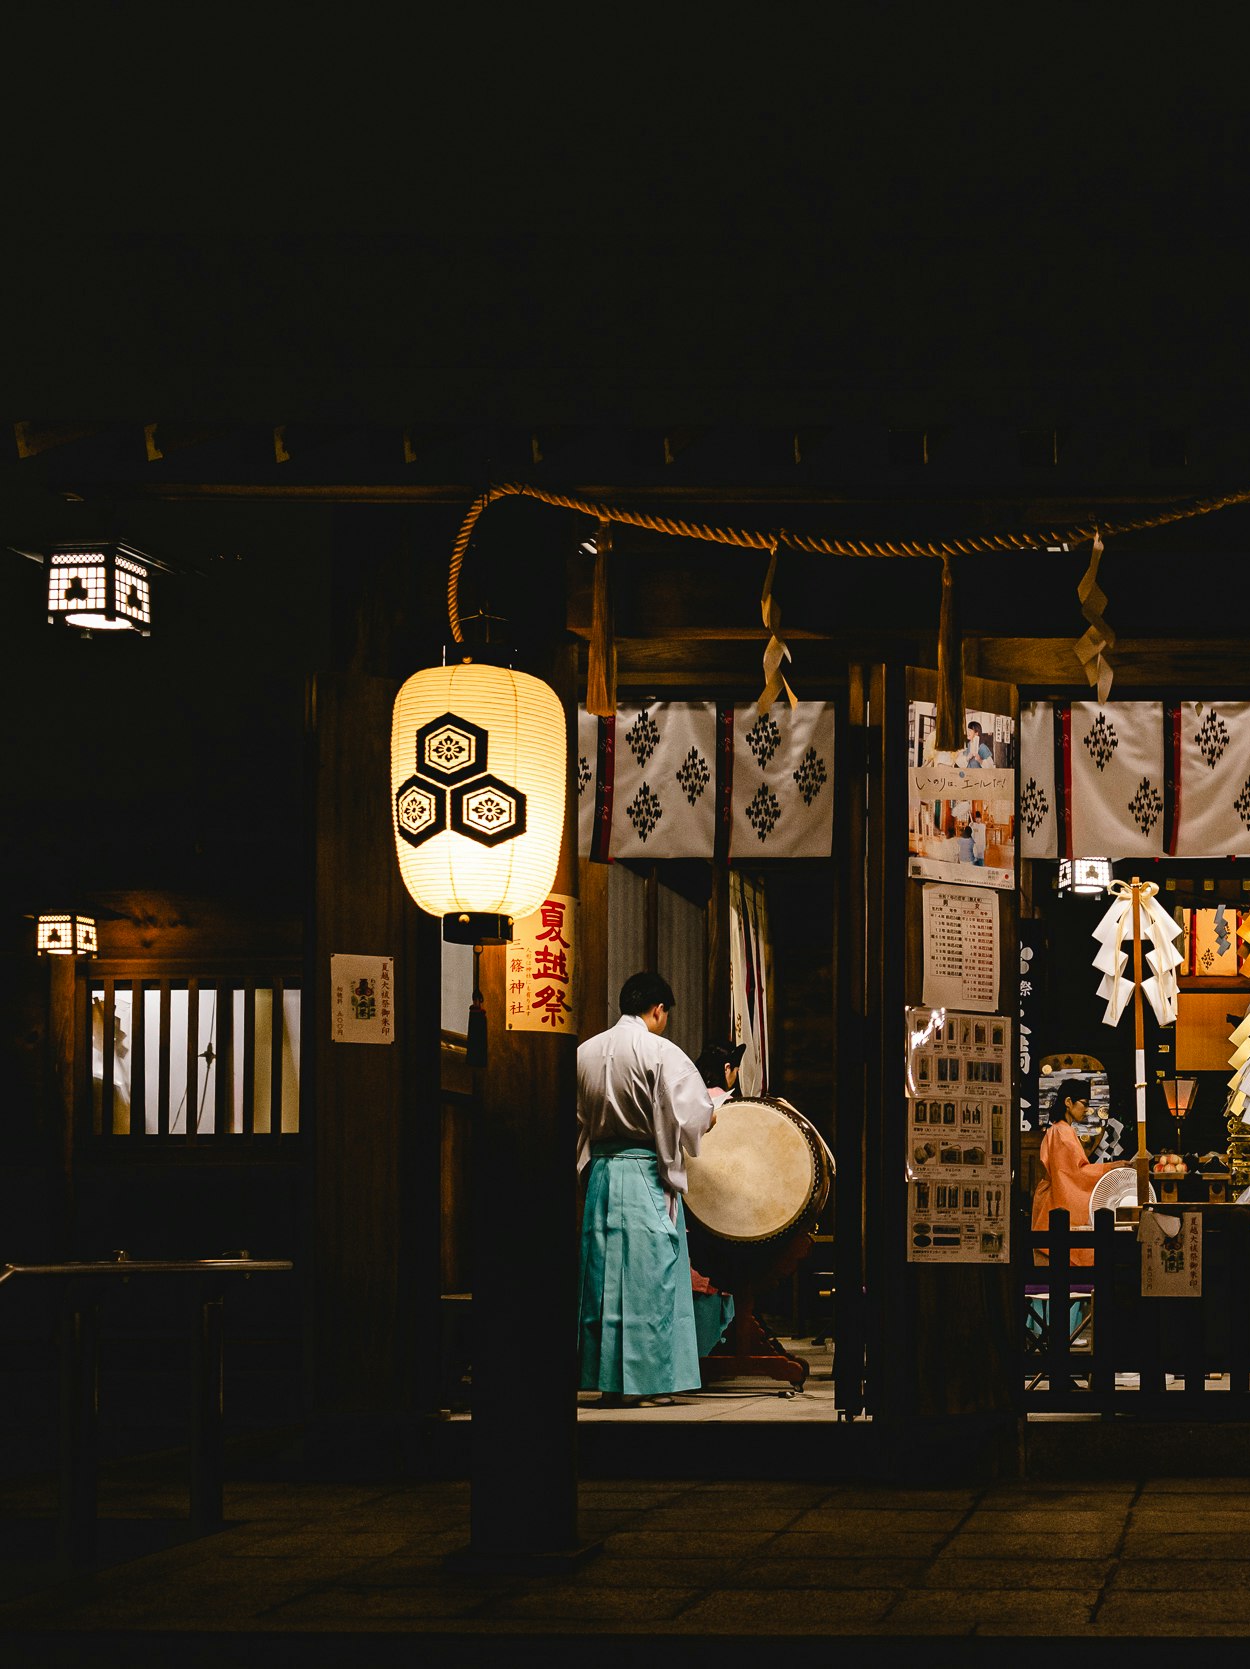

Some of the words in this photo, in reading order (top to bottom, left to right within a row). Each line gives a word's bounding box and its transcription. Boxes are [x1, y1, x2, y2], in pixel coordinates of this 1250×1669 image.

[509, 938, 525, 1015] 三篠神社
[532, 900, 572, 1027] 夏越祭
